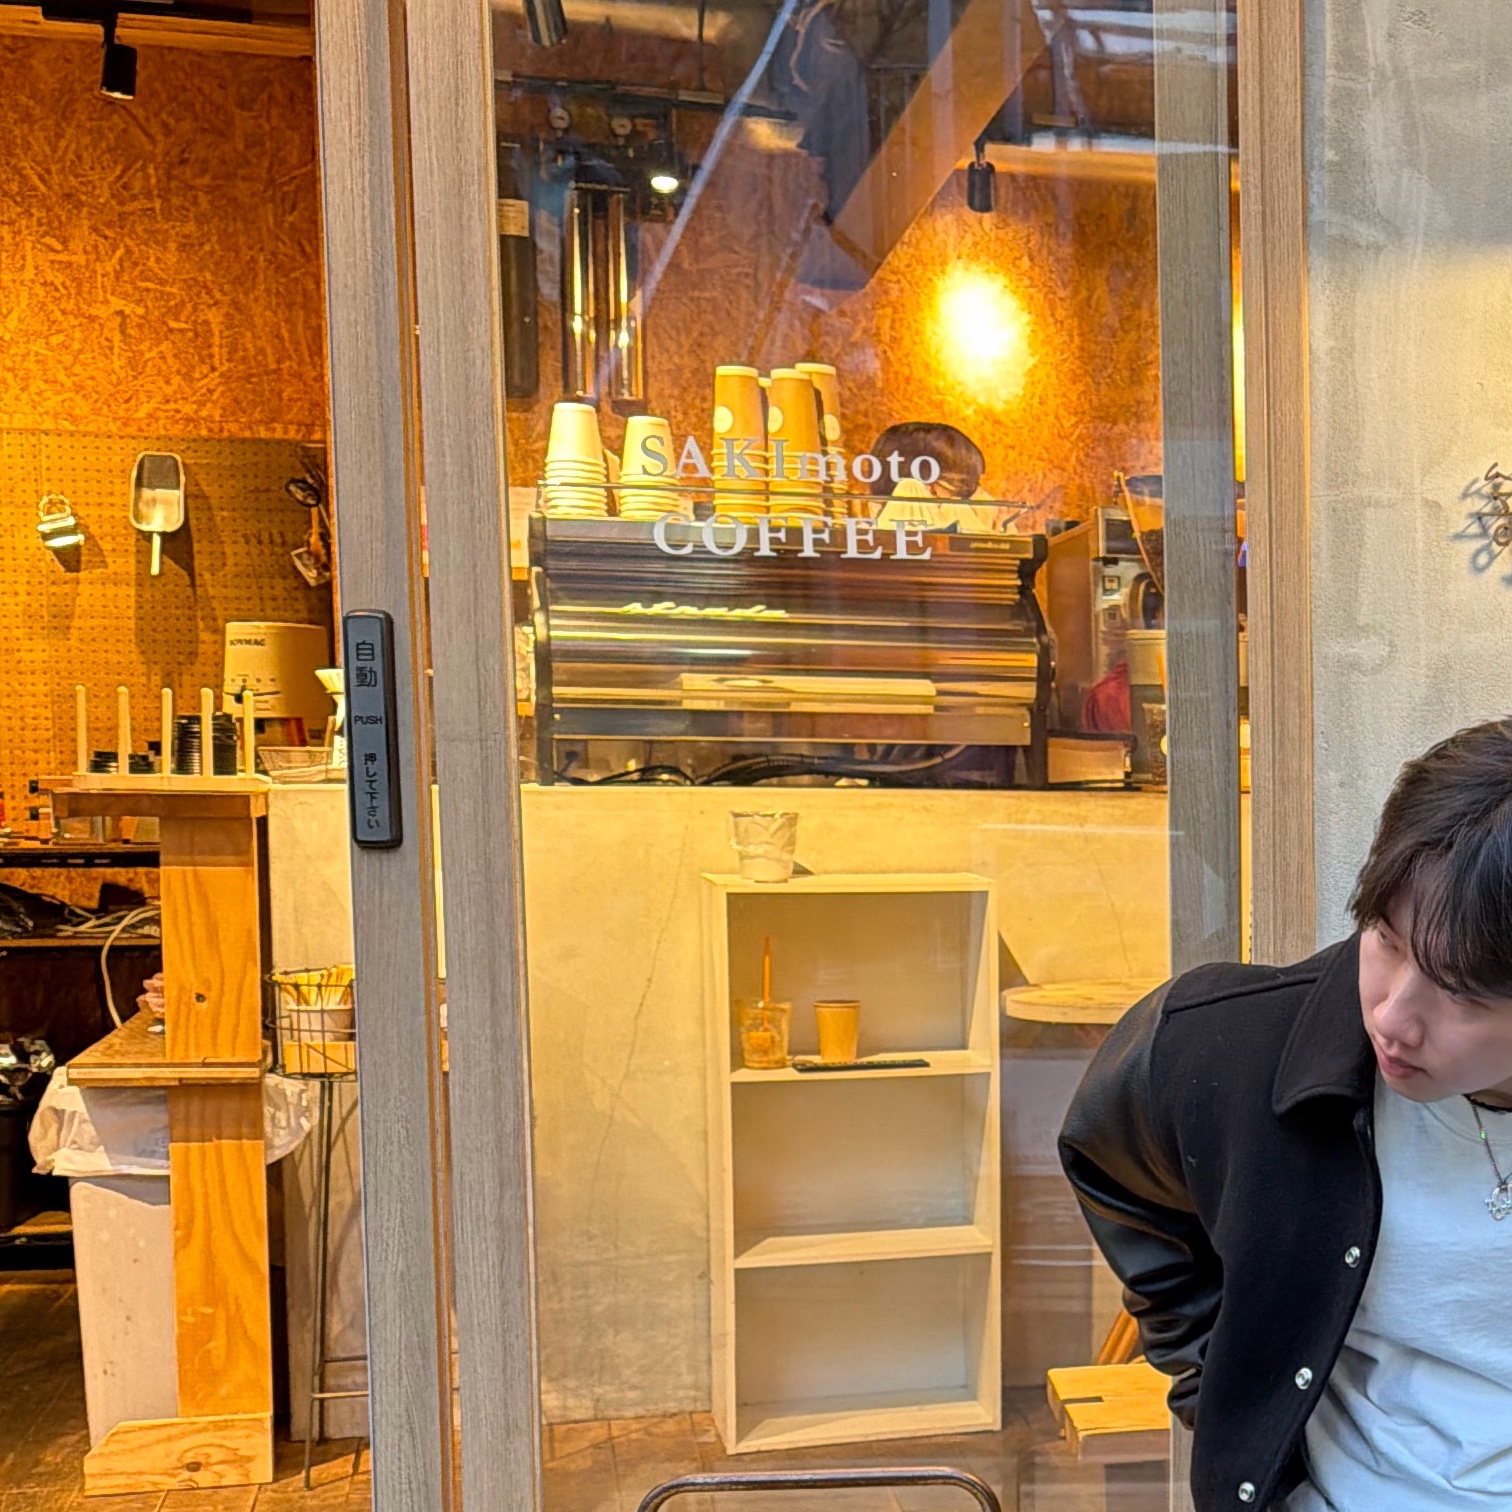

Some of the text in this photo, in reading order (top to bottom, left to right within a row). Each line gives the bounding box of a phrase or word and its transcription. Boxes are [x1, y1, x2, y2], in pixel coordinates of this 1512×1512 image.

[640, 435, 941, 485] SAKImoto
[653, 512, 933, 560] COFFEE
[355, 640, 378, 688] 自動
[354, 714, 383, 725] PUSH
[364, 752, 380, 829] 押して下さい
